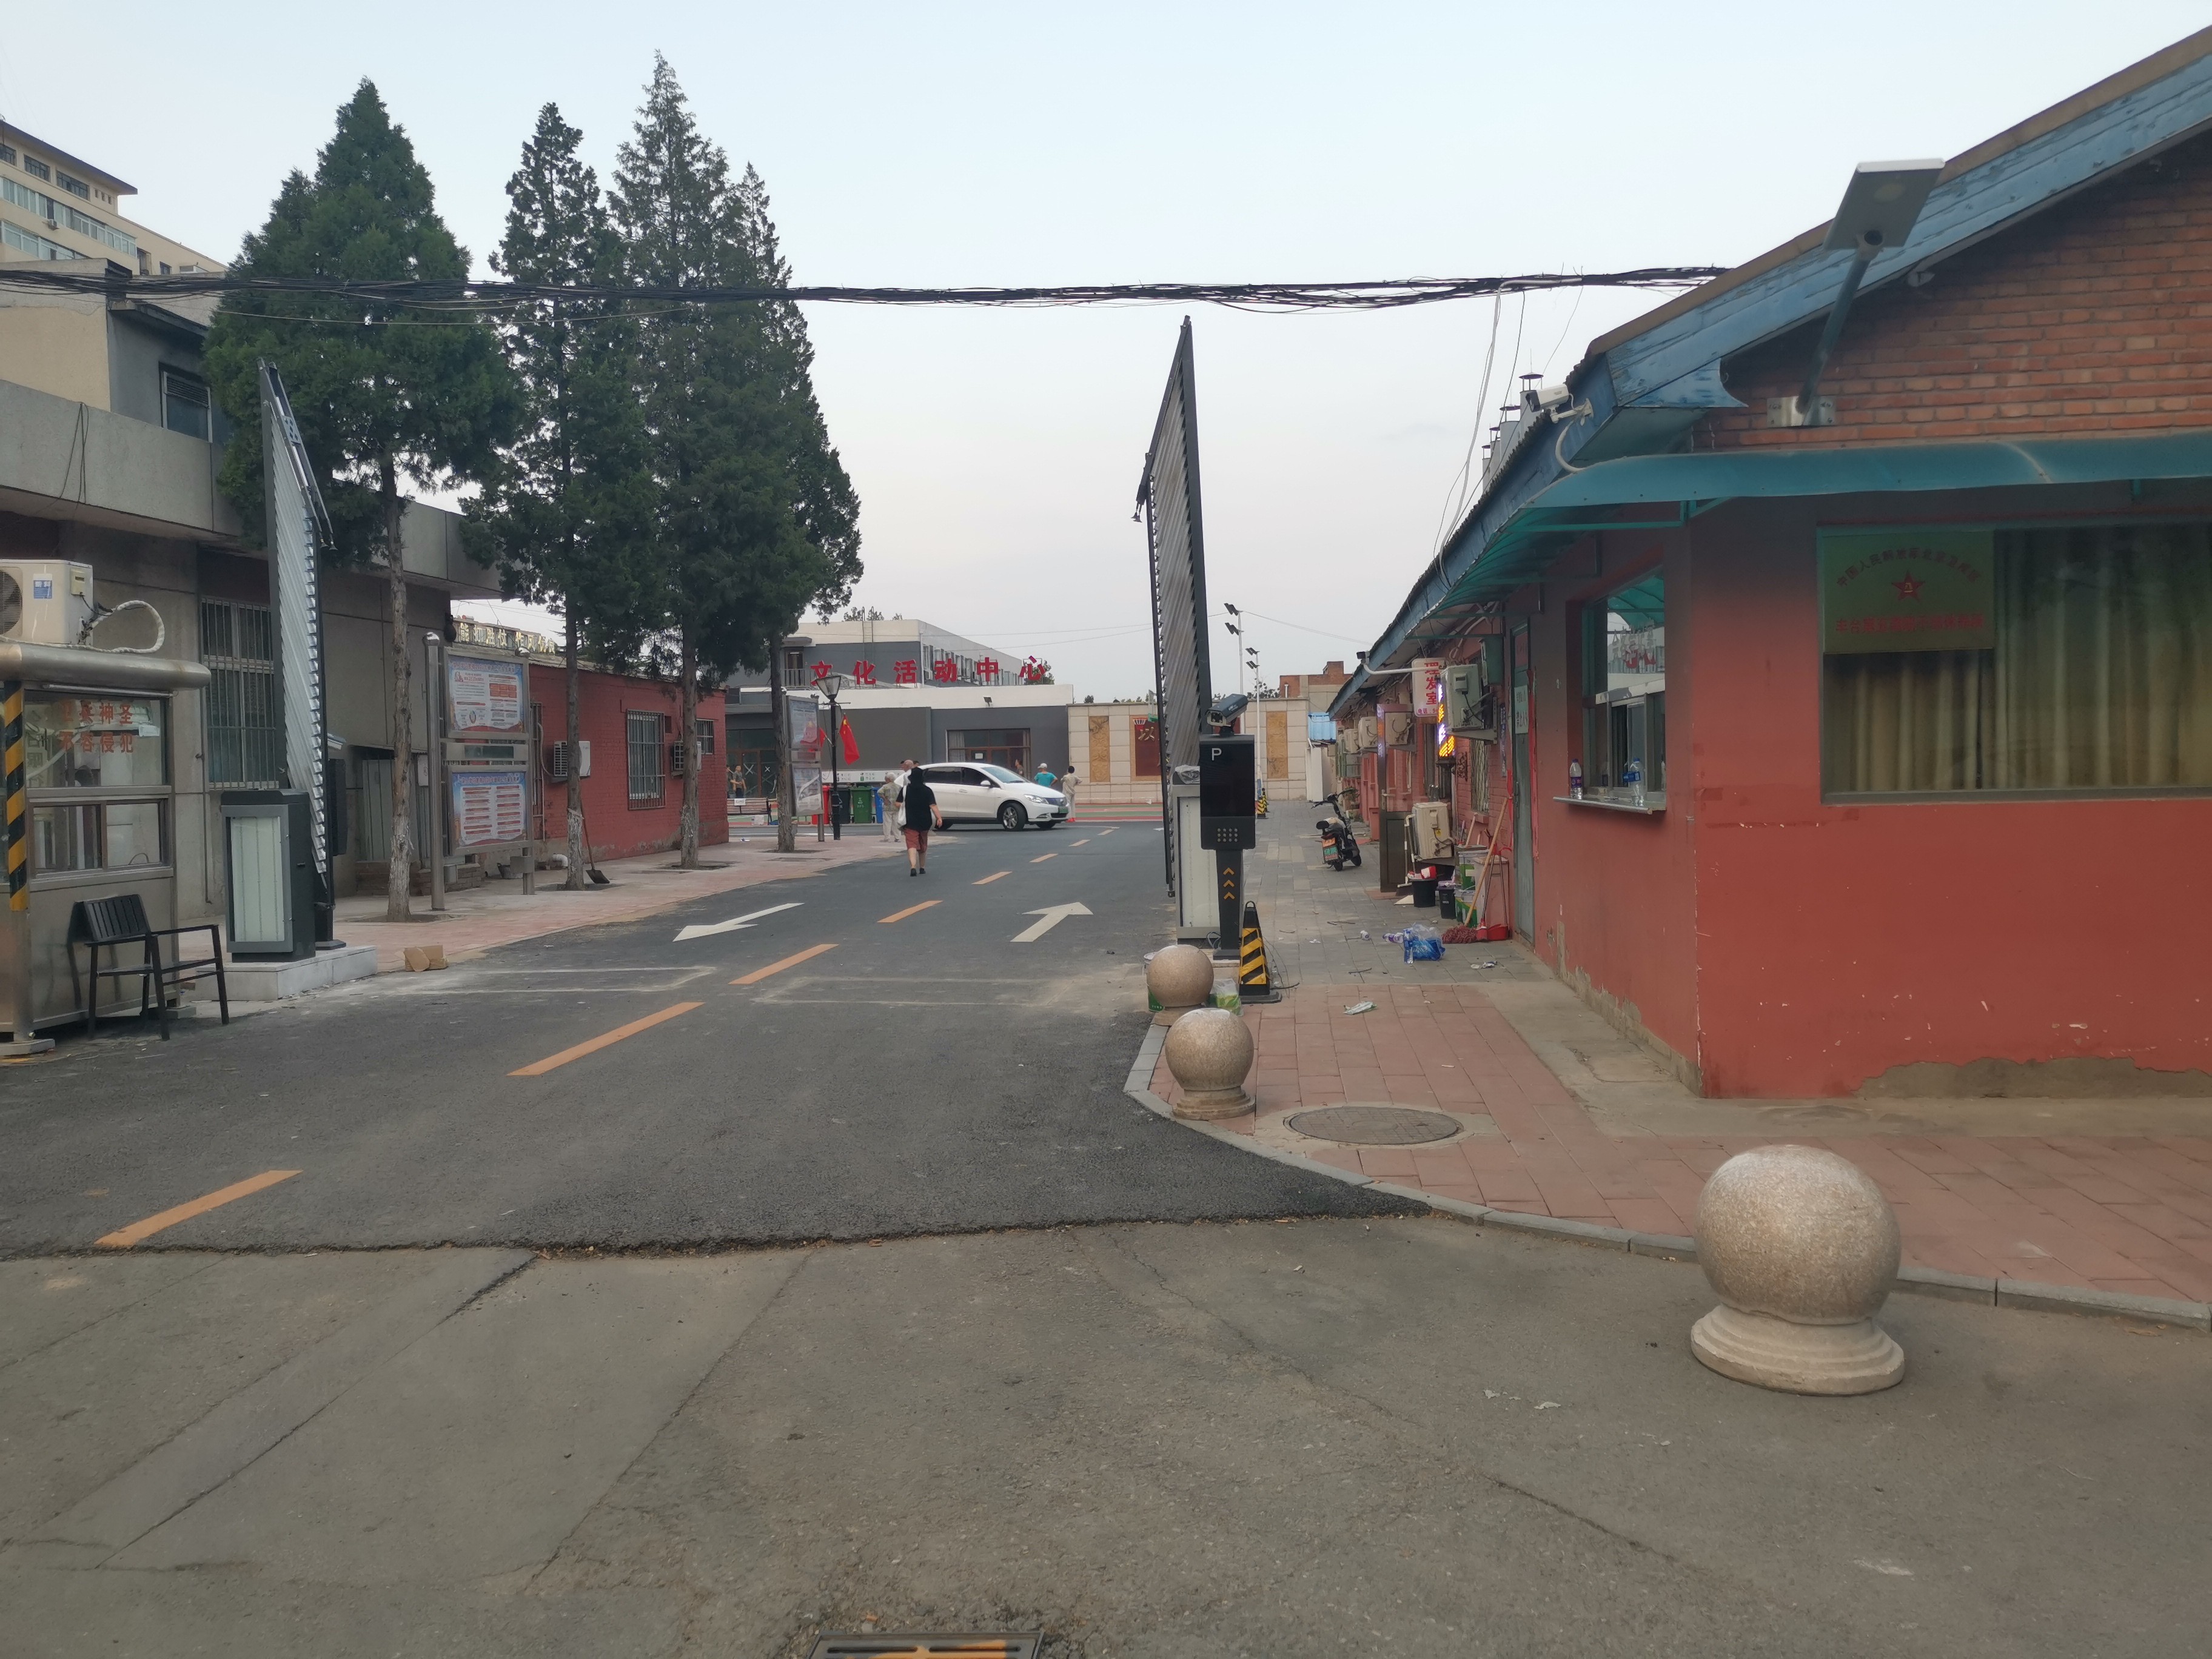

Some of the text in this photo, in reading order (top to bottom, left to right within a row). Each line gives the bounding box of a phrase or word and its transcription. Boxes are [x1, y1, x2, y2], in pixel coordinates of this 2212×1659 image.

[810, 655, 1045, 685] 文化活动中心
[61, 731, 133, 753] 不容侵犯
[1212, 748, 1222, 761] P
